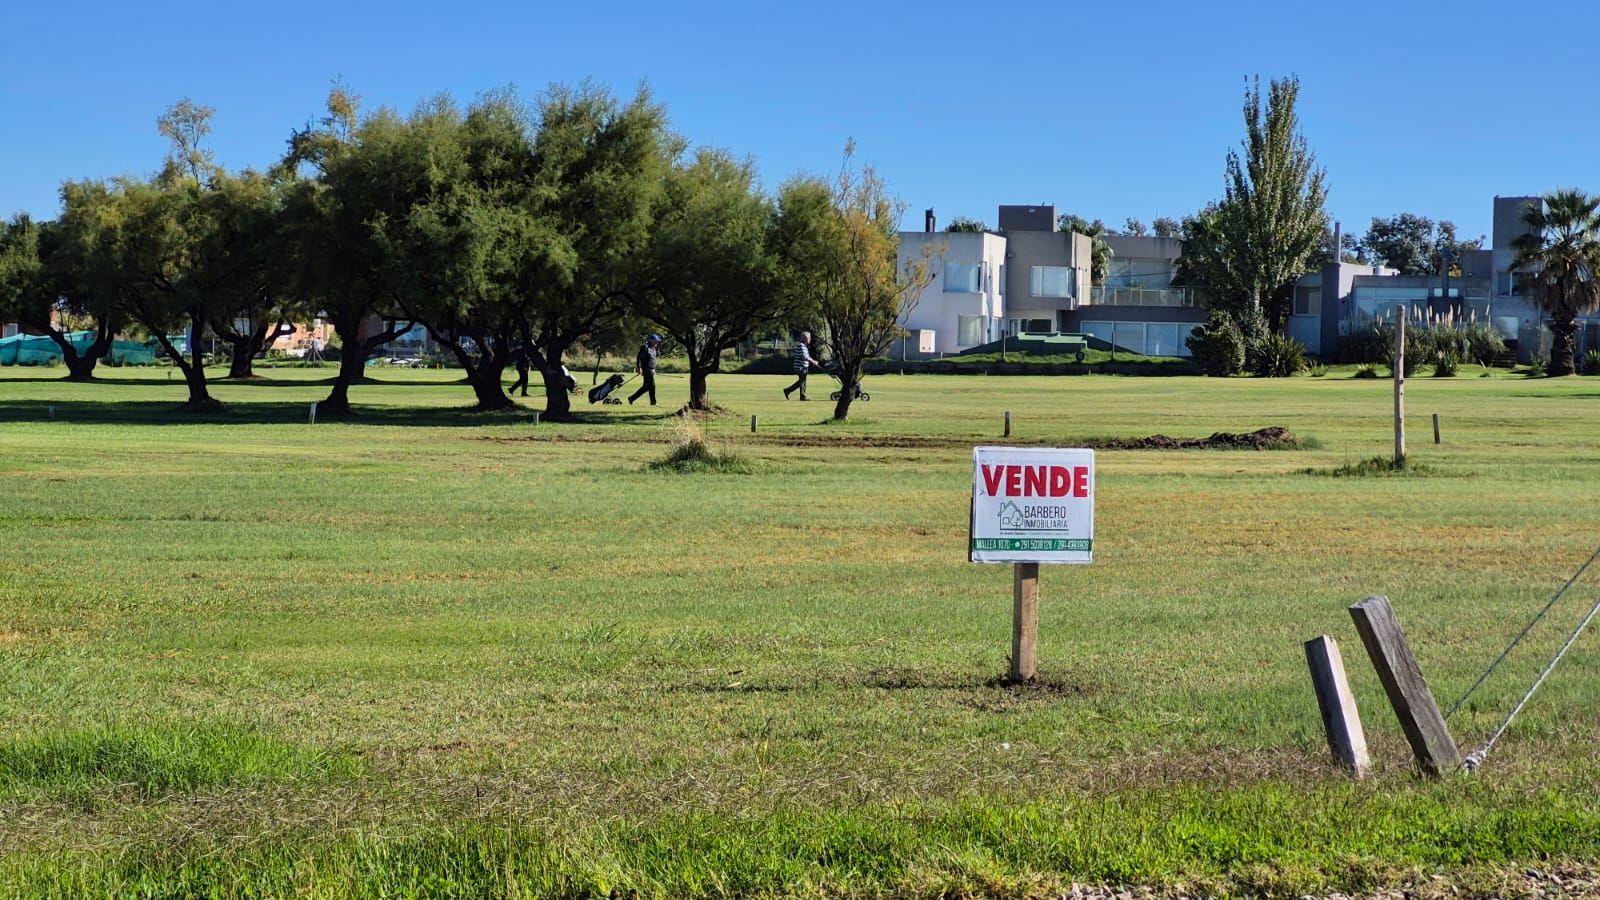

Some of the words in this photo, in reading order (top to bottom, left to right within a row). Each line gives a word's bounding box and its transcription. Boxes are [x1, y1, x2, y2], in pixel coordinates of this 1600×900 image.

[981, 464, 1088, 498] VENDE
[1024, 505, 1067, 519] BARBERO
[1024, 519, 1068, 529] INMOBILIARIA
